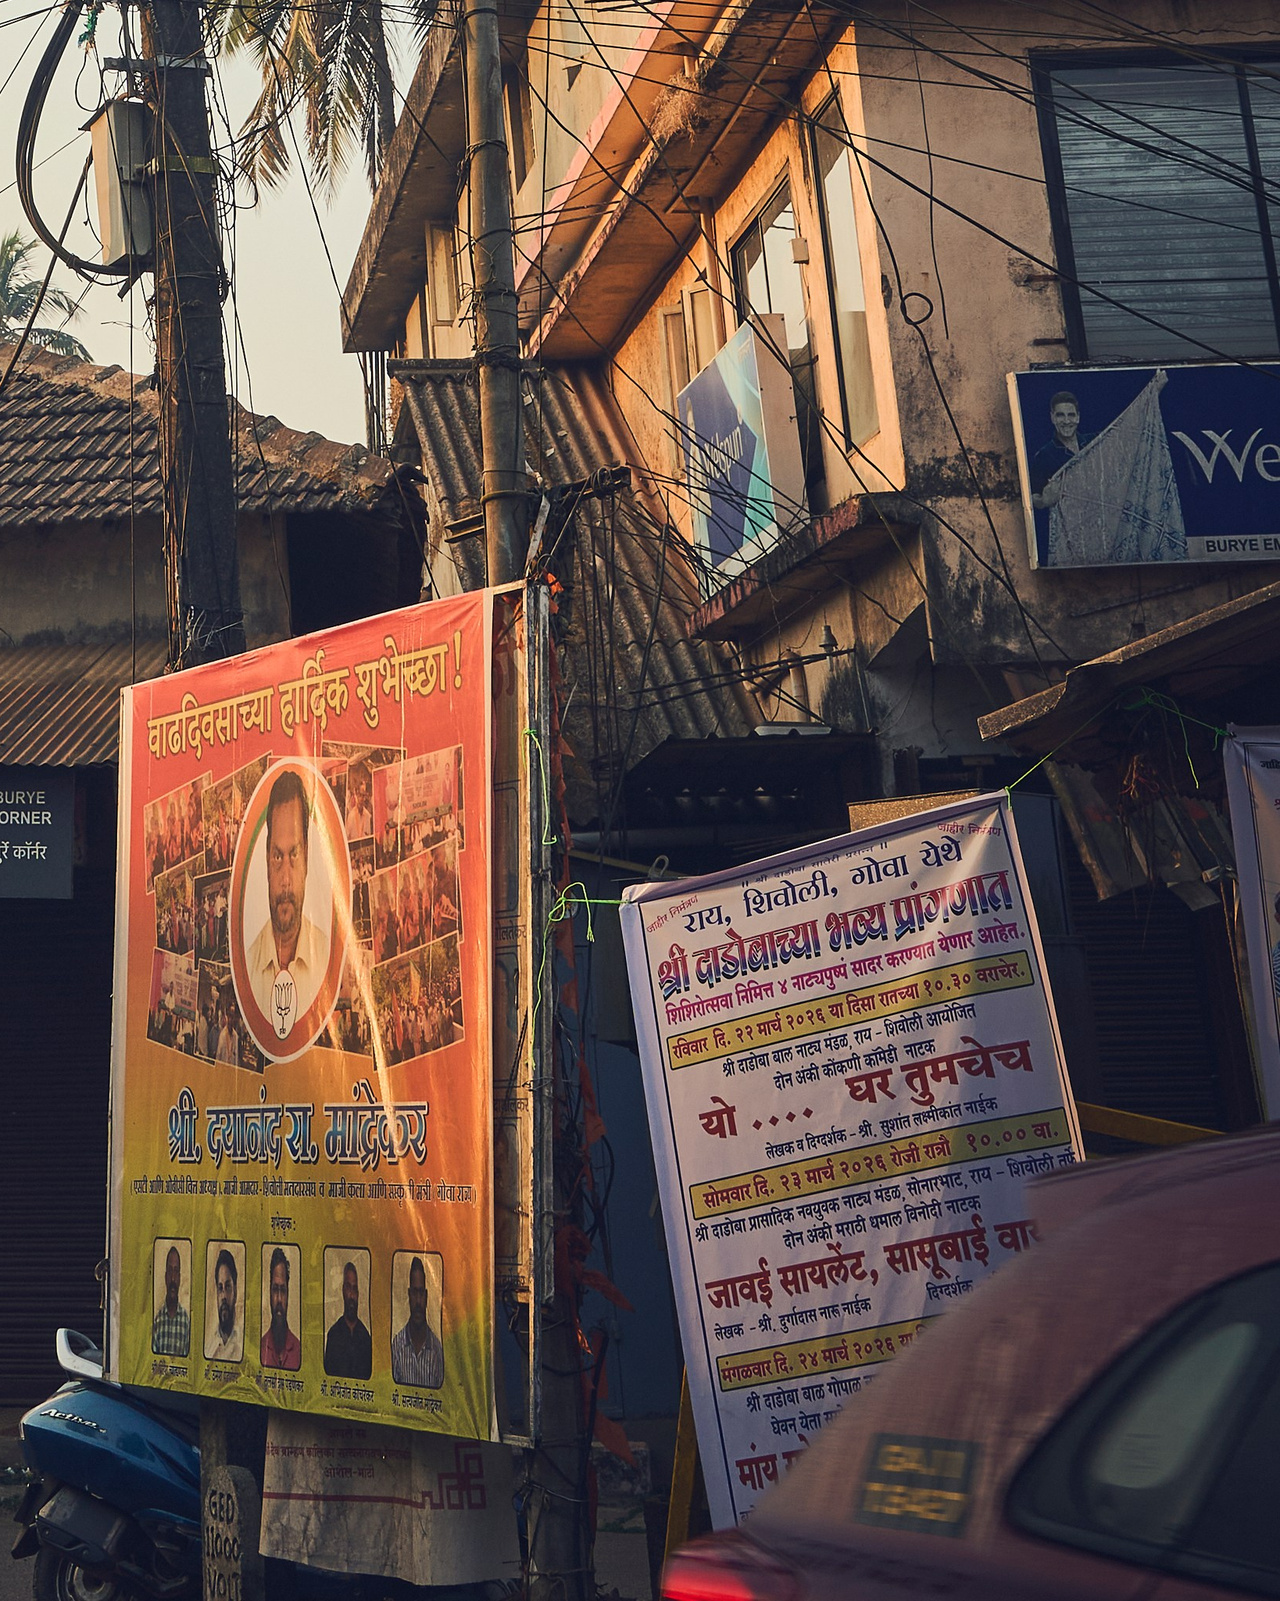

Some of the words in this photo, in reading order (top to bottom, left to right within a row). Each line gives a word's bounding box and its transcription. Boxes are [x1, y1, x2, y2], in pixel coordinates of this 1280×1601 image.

[701, 426, 744, 486] Welspun
[1205, 538, 1260, 553] BURYE
[147, 687, 274, 761] वाढदिवसाच्या
[279, 649, 350, 738] हार्दिक
[12, 841, 48, 860] कॉर्नर
[682, 904, 732, 933] राय,
[743, 870, 838, 918] शिवोली,
[850, 856, 910, 886] गोवा
[919, 835, 963, 868] येथे
[657, 943, 691, 1001] श्री
[692, 919, 821, 989] दाडोबाच्या
[825, 901, 889, 951] भव्य
[890, 869, 1013, 942] प्रांगणात
[735, 980, 774, 1006] निमित्त
[777, 979, 788, 994] ४
[791, 956, 848, 990] नाट्यपुष्पं
[851, 955, 883, 977] सादर
[885, 941, 935, 968] करण्यात
[938, 931, 975, 953] येणार
[977, 918, 1025, 945] आहेत.
[672, 1037, 709, 1060] रविवार
[713, 1028, 731, 1049] दि.
[735, 1025, 754, 1044] २२
[756, 1012, 782, 1036] मार्च
[786, 1008, 826, 1030] २०२६
[828, 1002, 845, 1019] या
[846, 994, 876, 1016] दिसा
[879, 982, 920, 1007] रातच्या
[923, 973, 971, 997] १०.३०
[722, 1058, 736, 1078] श्री
[737, 1052, 770, 1073] दाडोबा
[772, 1047, 793, 1064] बाल
[795, 1040, 822, 1057] नाट्य
[853, 1027, 872, 1046] राय
[884, 1011, 924, 1038] शिवोली
[926, 1002, 977, 1028] आयोजित
[698, 1095, 738, 1138] यो
[844, 1068, 897, 1104] घर
[900, 1036, 1034, 1107] तुमचेच
[773, 1071, 793, 1091] दोन
[796, 1062, 820, 1085] अंकी
[822, 1053, 862, 1078] कोंकणी
[904, 1039, 936, 1064] नाटक
[168, 1086, 201, 1163] श्री.
[206, 1084, 283, 1167] दयानंद
[285, 1103, 319, 1164] रा.
[323, 1079, 429, 1171] मांद्रेकर
[765, 1141, 794, 1160] लेखक
[796, 1139, 805, 1151] व
[805, 1125, 847, 1149] दिग्दर्शक
[858, 1119, 877, 1138] श्री.
[879, 1112, 911, 1138] सुशांत
[912, 1101, 963, 1126] लक्ष्मीकांत
[964, 1092, 998, 1114] नाईक
[328, 1176, 346, 1199] माजी
[348, 1182, 366, 1199] कला
[368, 1177, 387, 1200] आणि
[695, 1222, 709, 1243] श्री
[711, 1217, 747, 1239] दाडोबा
[749, 1206, 795, 1231] प्रासादिक
[796, 1198, 840, 1222] नवयुवक
[842, 1190, 872, 1209] नाट्य
[969, 1166, 992, 1185] राय
[1007, 1152, 1054, 1178] शिवोली
[703, 1185, 752, 1209] सोमवार
[754, 1174, 775, 1197] दि.
[780, 1171, 802, 1192] २३
[805, 1158, 835, 1184] मार्च
[839, 1154, 887, 1179] २०२६
[890, 1141, 921, 1167] रोजी
[966, 1130, 1027, 1153] १०.००
[1031, 1122, 1059, 1140] वा.
[783, 1229, 804, 1249] दोन
[807, 1221, 833, 1244] अंकी
[835, 1214, 867, 1237] मराठी
[870, 1210, 902, 1230] धमाल
[904, 1199, 943, 1224] विनोदी
[946, 1195, 982, 1215] नाटक
[705, 1257, 773, 1309] जावई
[777, 1241, 879, 1297] सायलेंट,
[883, 1213, 990, 1280] सासूबाई
[714, 1323, 744, 1341] लेखक
[758, 1314, 777, 1333] श्री.
[778, 1306, 817, 1333] दुर्गादास
[818, 1304, 841, 1320] नारू
[841, 1293, 871, 1316] नाईक
[926, 1275, 974, 1301] दिग्दर्शक
[721, 1361, 772, 1383] मंगळवार
[773, 1351, 793, 1374] दि.
[798, 1352, 819, 1370] २४
[821, 1339, 850, 1363] मार्च
[853, 1337, 896, 1359] २०२६
[40, 1407, 101, 1429] Activa
[746, 1391, 762, 1413] श्री
[763, 1386, 800, 1411] दाडोबा
[801, 1383, 825, 1404] बाळ
[826, 1376, 862, 1398] गोपाळ
[771, 1416, 798, 1437] घेवन
[799, 1410, 822, 1432] येता
[735, 1442, 780, 1491] मांय
